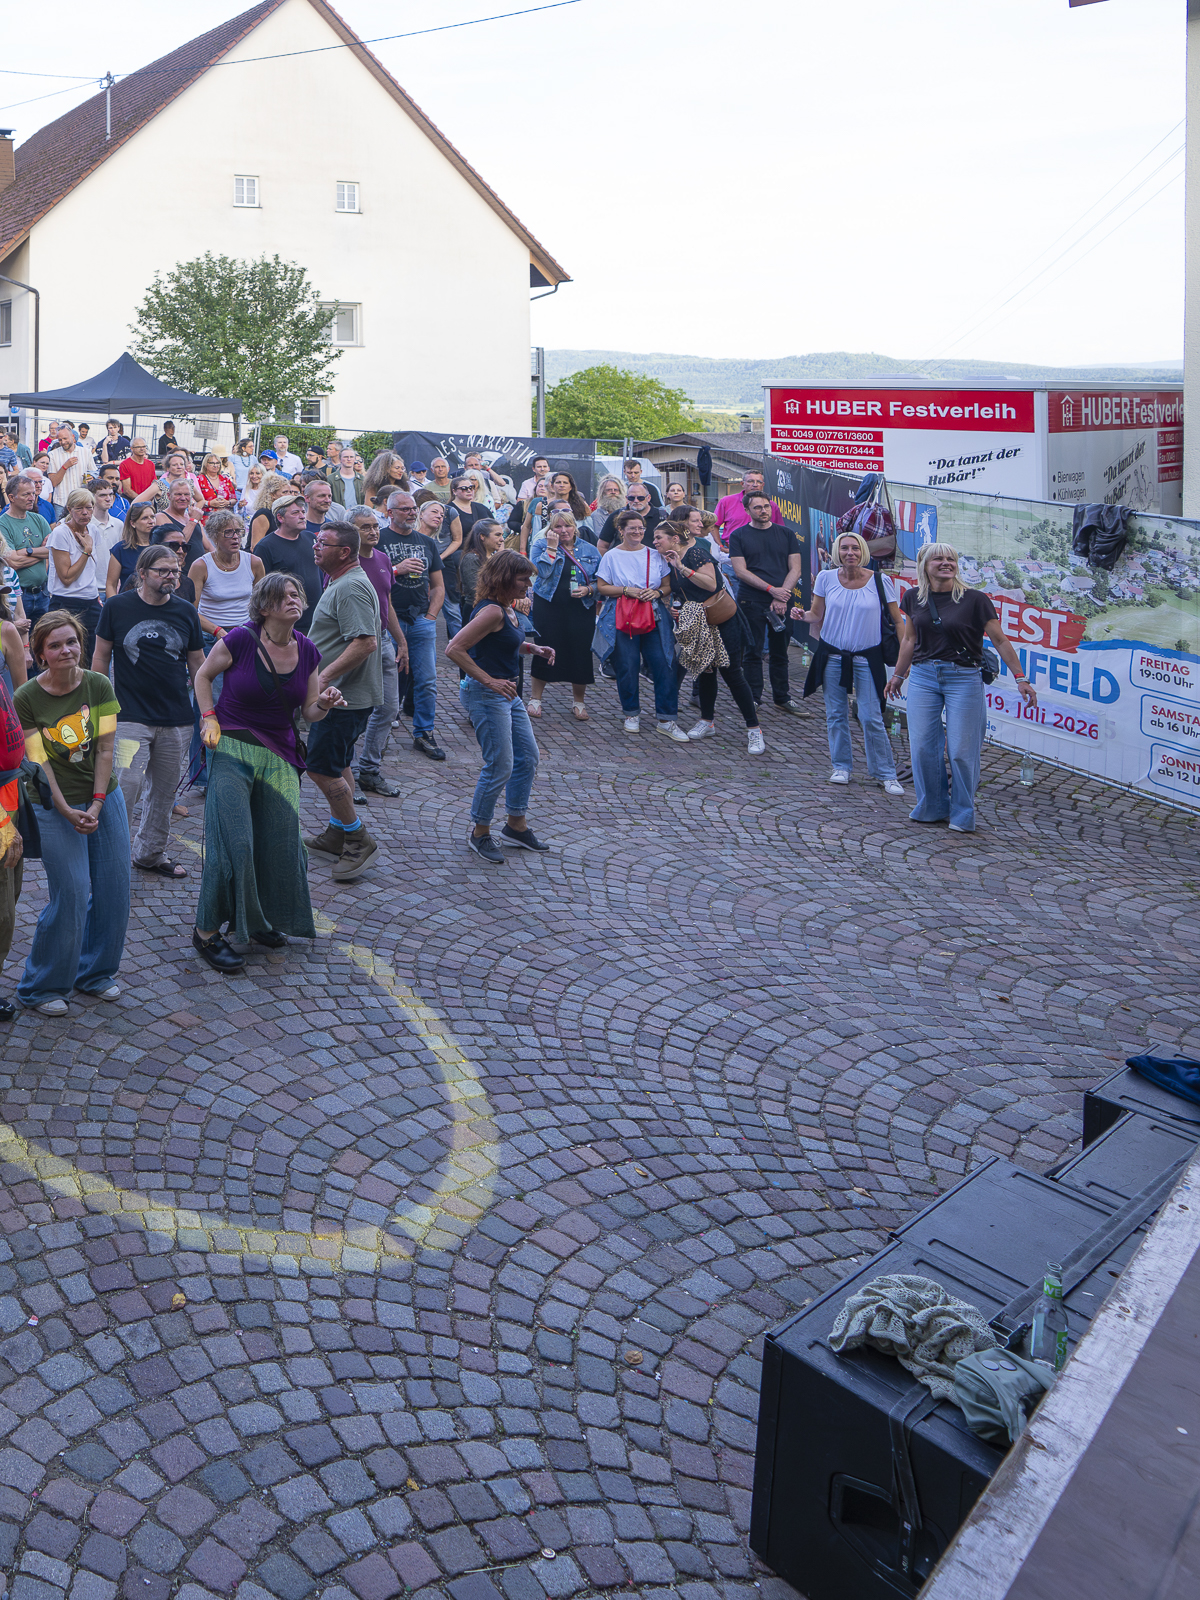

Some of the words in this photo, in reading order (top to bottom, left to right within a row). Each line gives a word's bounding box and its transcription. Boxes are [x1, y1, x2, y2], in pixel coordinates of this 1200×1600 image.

[806, 400, 883, 416] HUBER
[889, 401, 1017, 421] Festverleih
[1081, 396, 1131, 426] HUBER
[776, 429, 791, 438] Tel.
[792, 430, 814, 439] 0049
[815, 430, 874, 441] (0)7761/3600
[435, 436, 457, 459] LES
[467, 434, 538, 467] NARCOTIK
[776, 443, 792, 451] Fax
[793, 444, 815, 452] 0049
[817, 444, 875, 455] (0)7761/3444
[958, 450, 994, 467] tanzt
[996, 448, 1021, 460] der
[1117, 447, 1135, 475] tanzt
[1134, 440, 1146, 461] der
[1057, 471, 1085, 485] Bierwagen
[1057, 488, 1087, 501] Kühlwagen
[1140, 656, 1190, 676] FREITAG
[1140, 668, 1171, 683] 19:00
[1173, 675, 1194, 689] Uhr
[985, 693, 1009, 714] 19.
[1014, 702, 1046, 724] Juli
[1052, 712, 1099, 740] 2026
[1150, 718, 1165, 729] ab
[1167, 720, 1180, 733] 16
[1157, 767, 1174, 778] ab
[1176, 771, 1190, 783] 12
